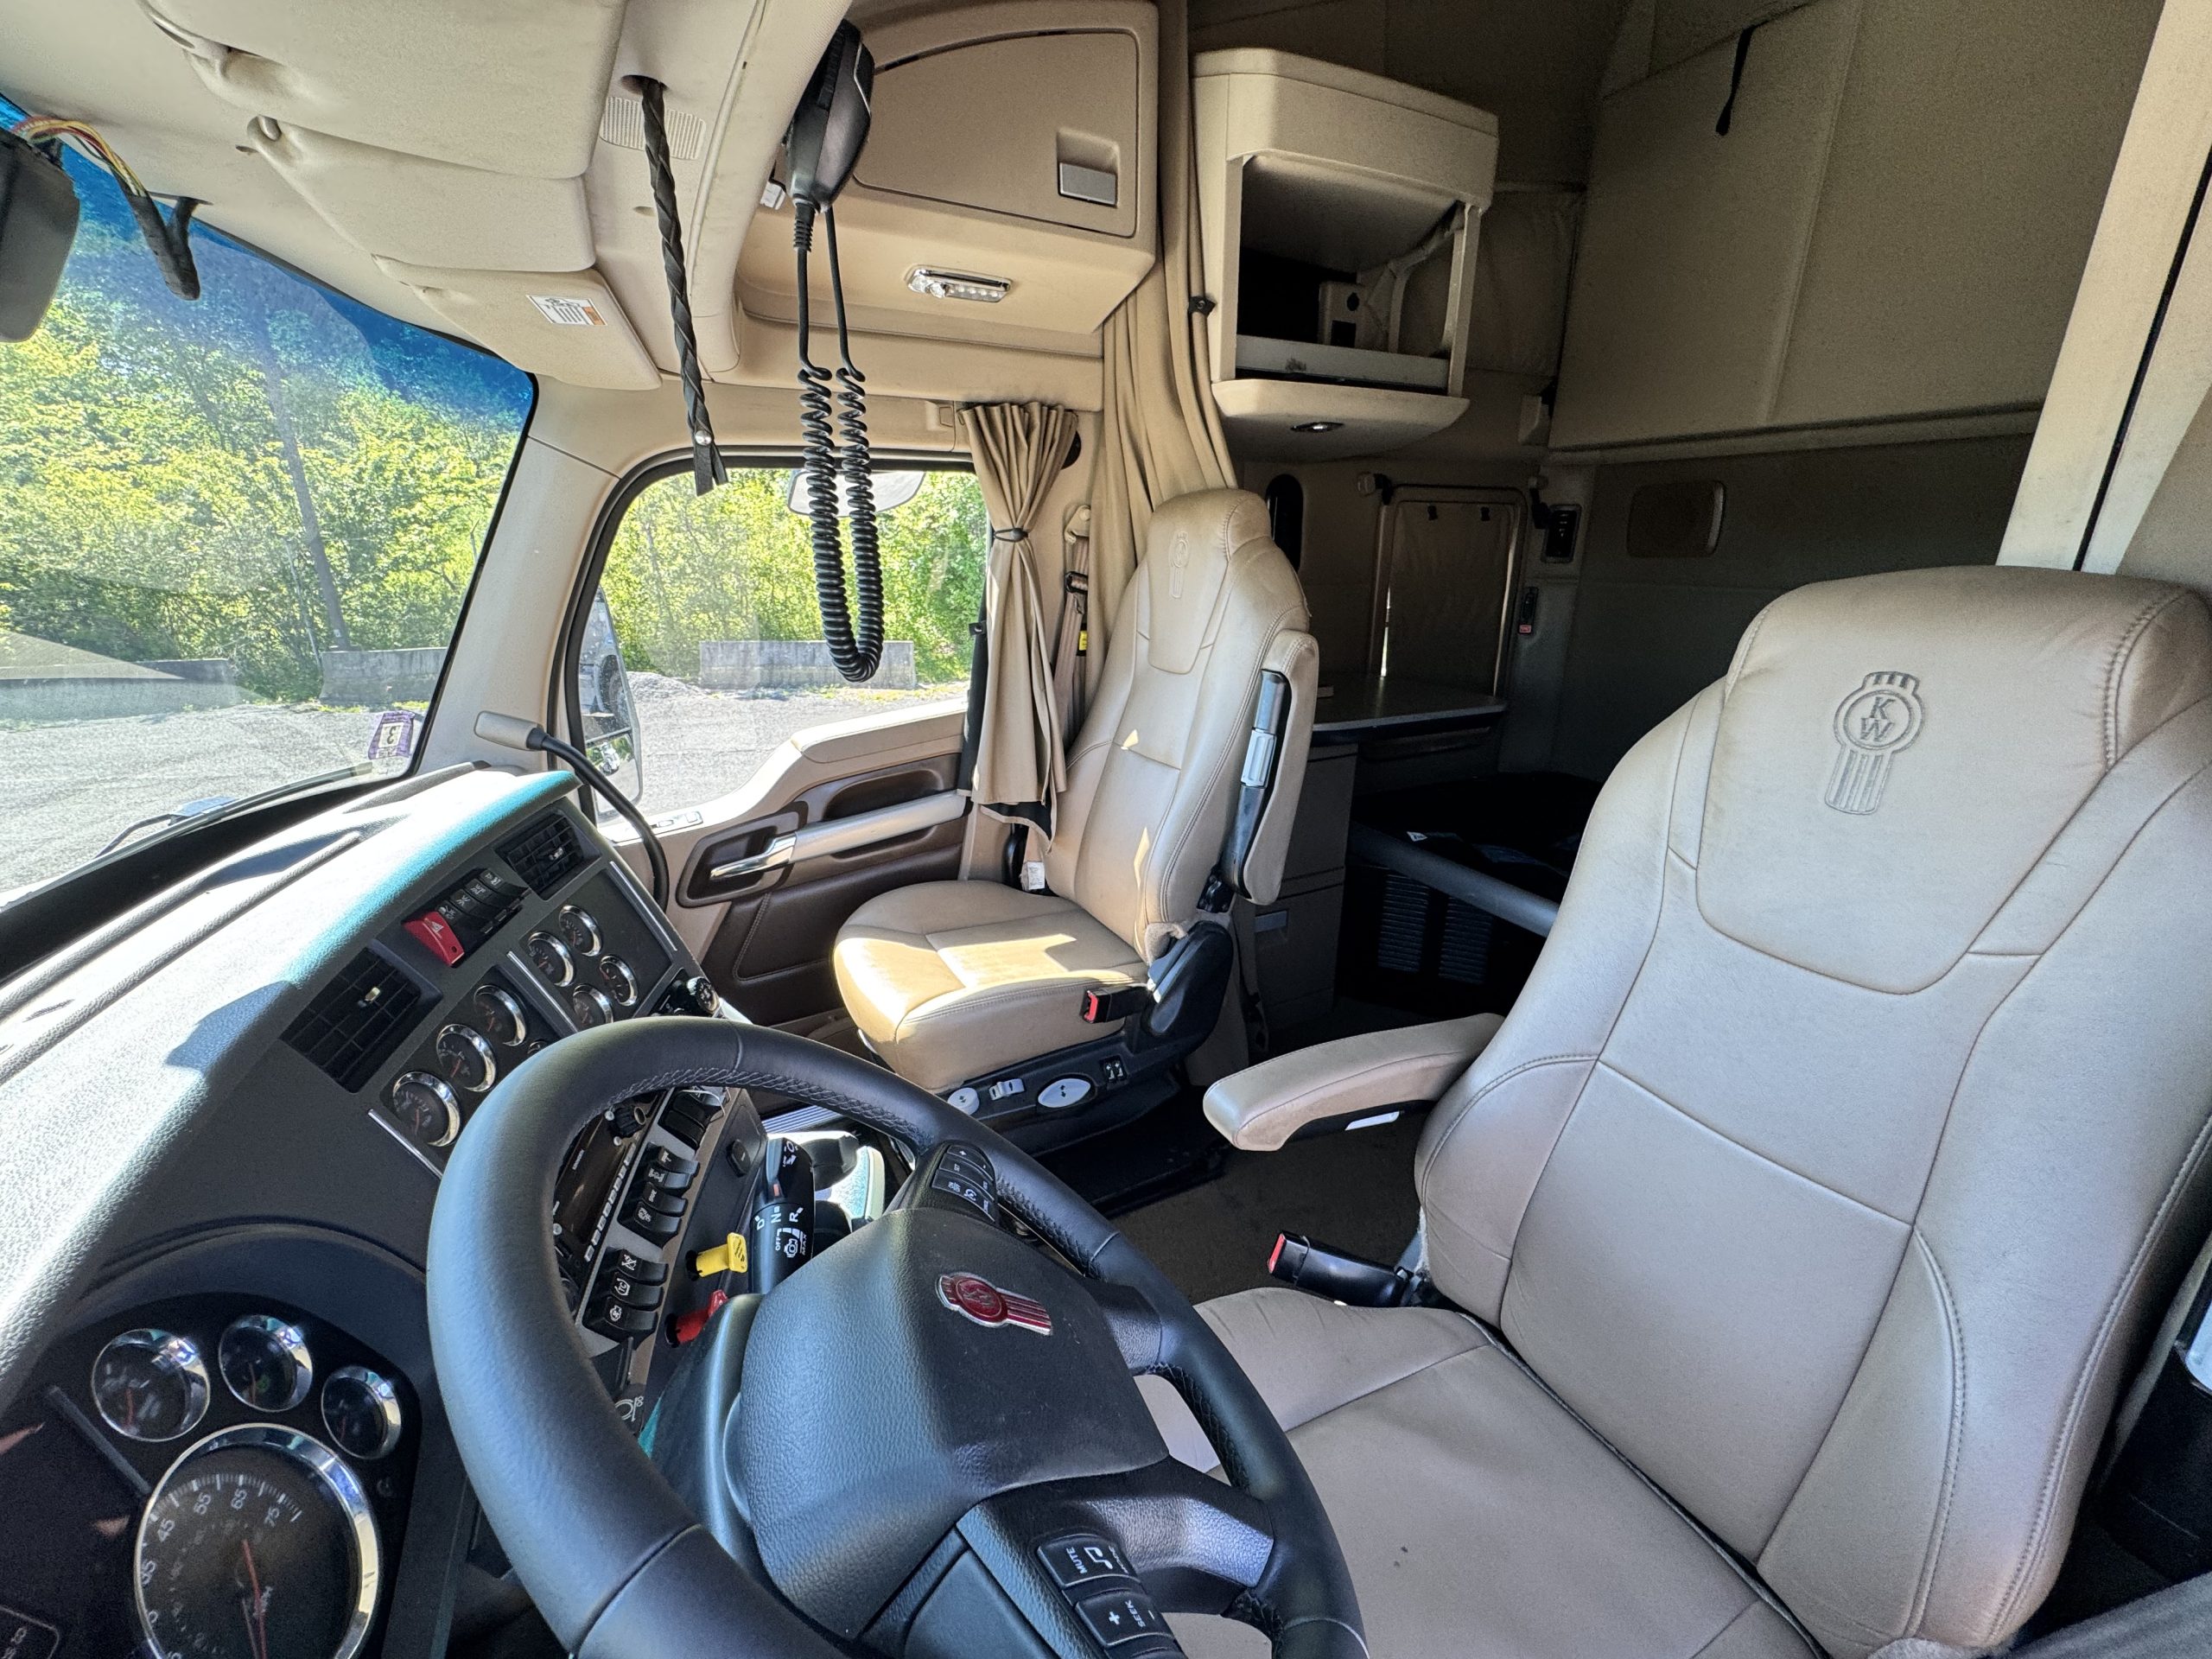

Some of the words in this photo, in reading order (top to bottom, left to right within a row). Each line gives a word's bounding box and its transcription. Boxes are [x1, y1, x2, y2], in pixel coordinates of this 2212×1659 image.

[756, 1218, 766, 1230] D
[771, 1213, 782, 1224] N
[789, 1211, 799, 1223] R
[230, 1488, 248, 1510] 65
[263, 1505, 281, 1528] 75
[156, 1518, 176, 1542] 45
[1065, 1546, 1088, 1574] MUTE
[1124, 1599, 1147, 1628] SEEK
